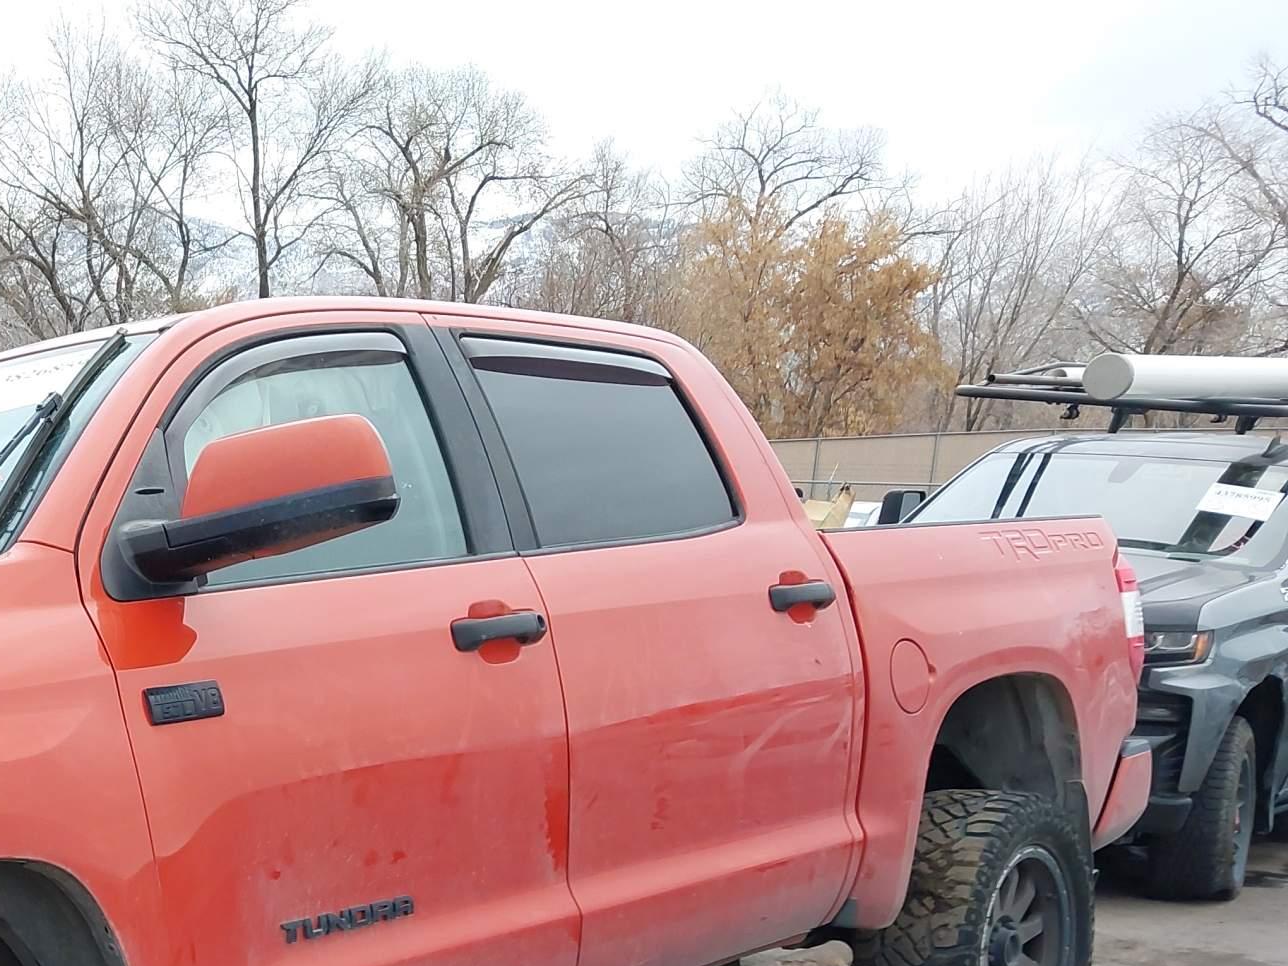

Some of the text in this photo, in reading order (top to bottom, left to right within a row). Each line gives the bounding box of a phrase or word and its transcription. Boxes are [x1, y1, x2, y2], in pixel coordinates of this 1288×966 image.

[978, 528, 1105, 561] TRD PRO
[194, 686, 221, 712] V8
[280, 895, 415, 944] TUNDRA
